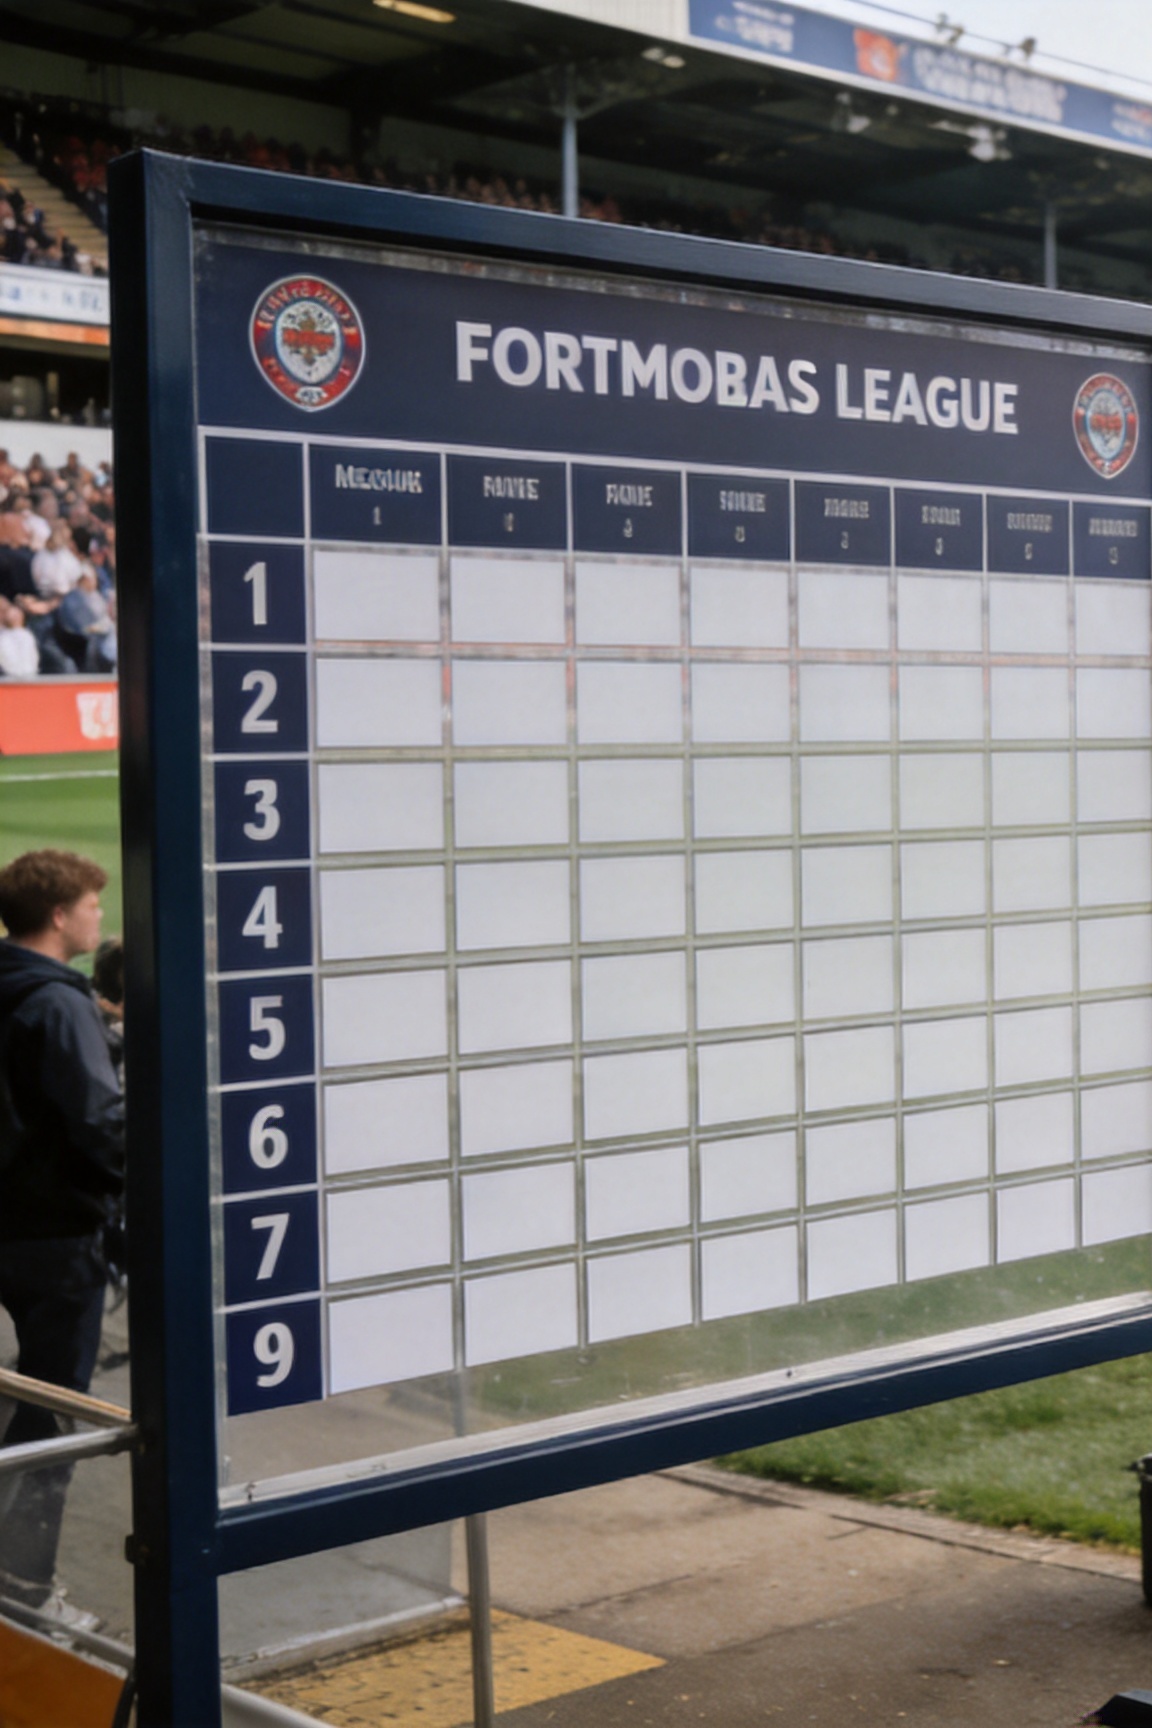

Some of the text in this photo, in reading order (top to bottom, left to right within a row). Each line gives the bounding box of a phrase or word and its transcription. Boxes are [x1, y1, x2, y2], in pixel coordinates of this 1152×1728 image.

[456, 321, 821, 415] FORTMOBAS
[836, 363, 1019, 436] LEAGUE
[243, 561, 267, 625] 1
[241, 670, 279, 734] 2
[243, 779, 281, 842] 3
[242, 885, 283, 949] 4
[248, 995, 286, 1060] 5
[248, 1104, 289, 1169] 6
[250, 1213, 290, 1281] 7
[253, 1322, 294, 1387] 9
